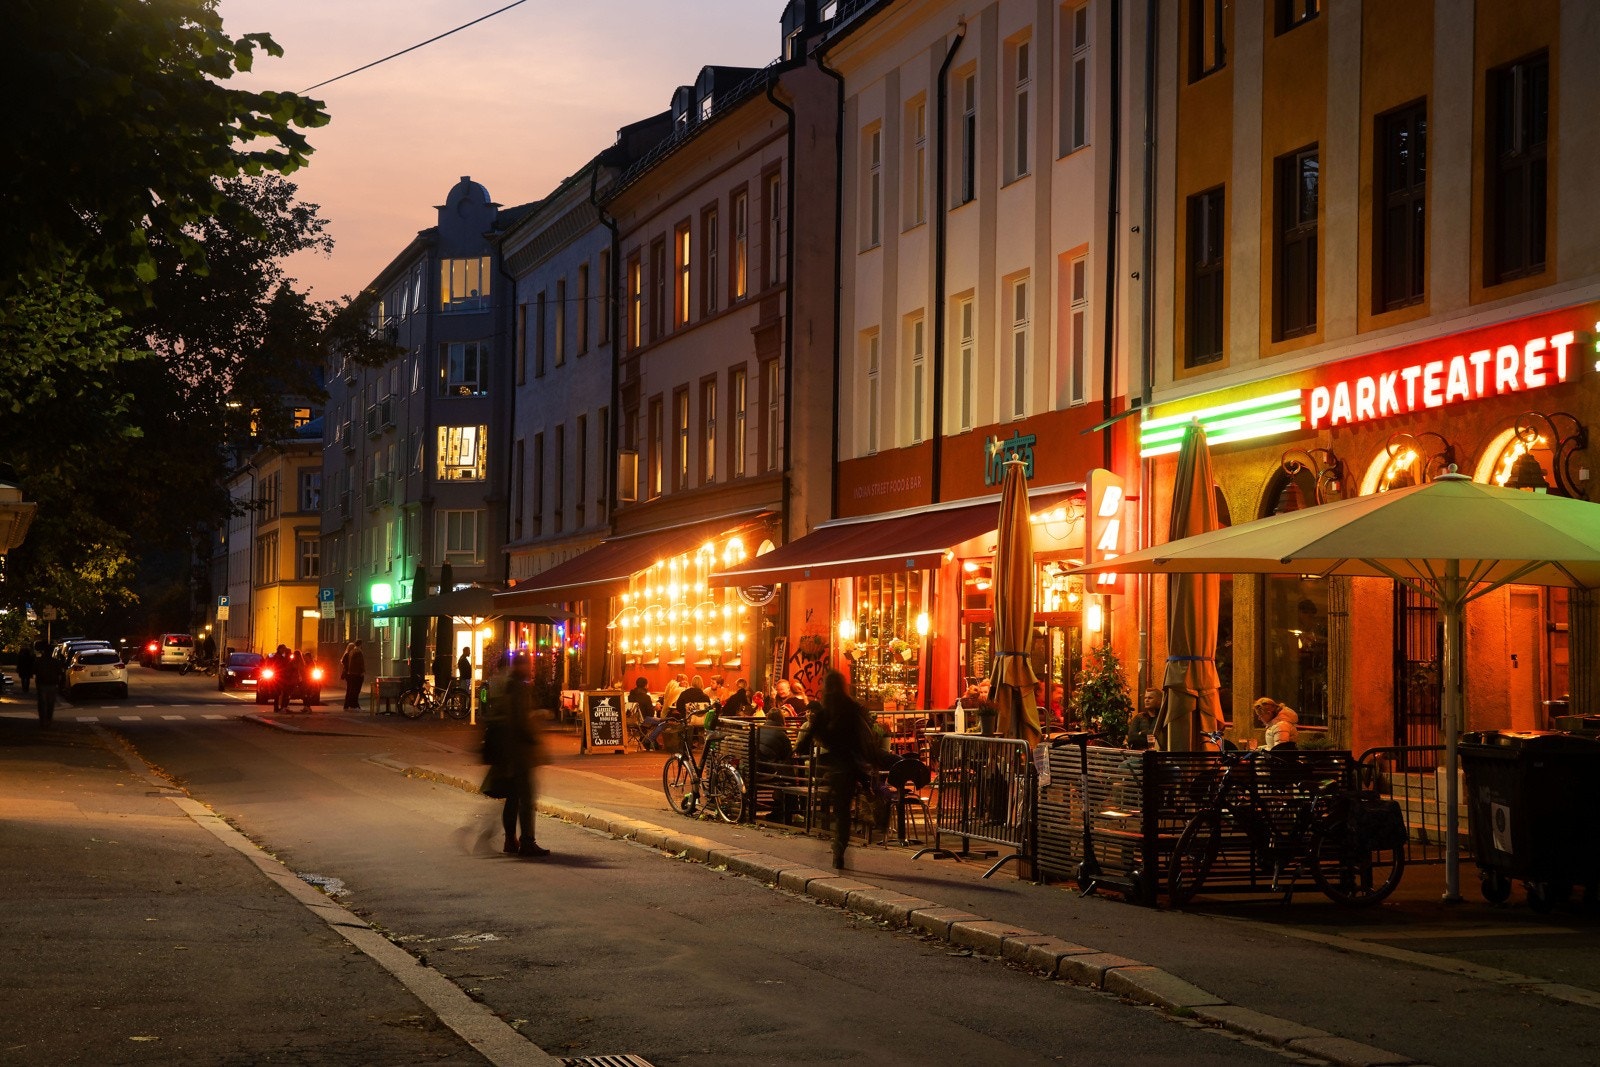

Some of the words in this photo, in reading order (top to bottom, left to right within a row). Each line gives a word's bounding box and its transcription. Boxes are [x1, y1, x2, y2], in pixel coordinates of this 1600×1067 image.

[1310, 330, 1575, 430] PARKTEATRET
[871, 481, 889, 496] STREET
[890, 478, 905, 493] FOOD
[910, 475, 922, 489] BAR
[323, 589, 331, 600] P
